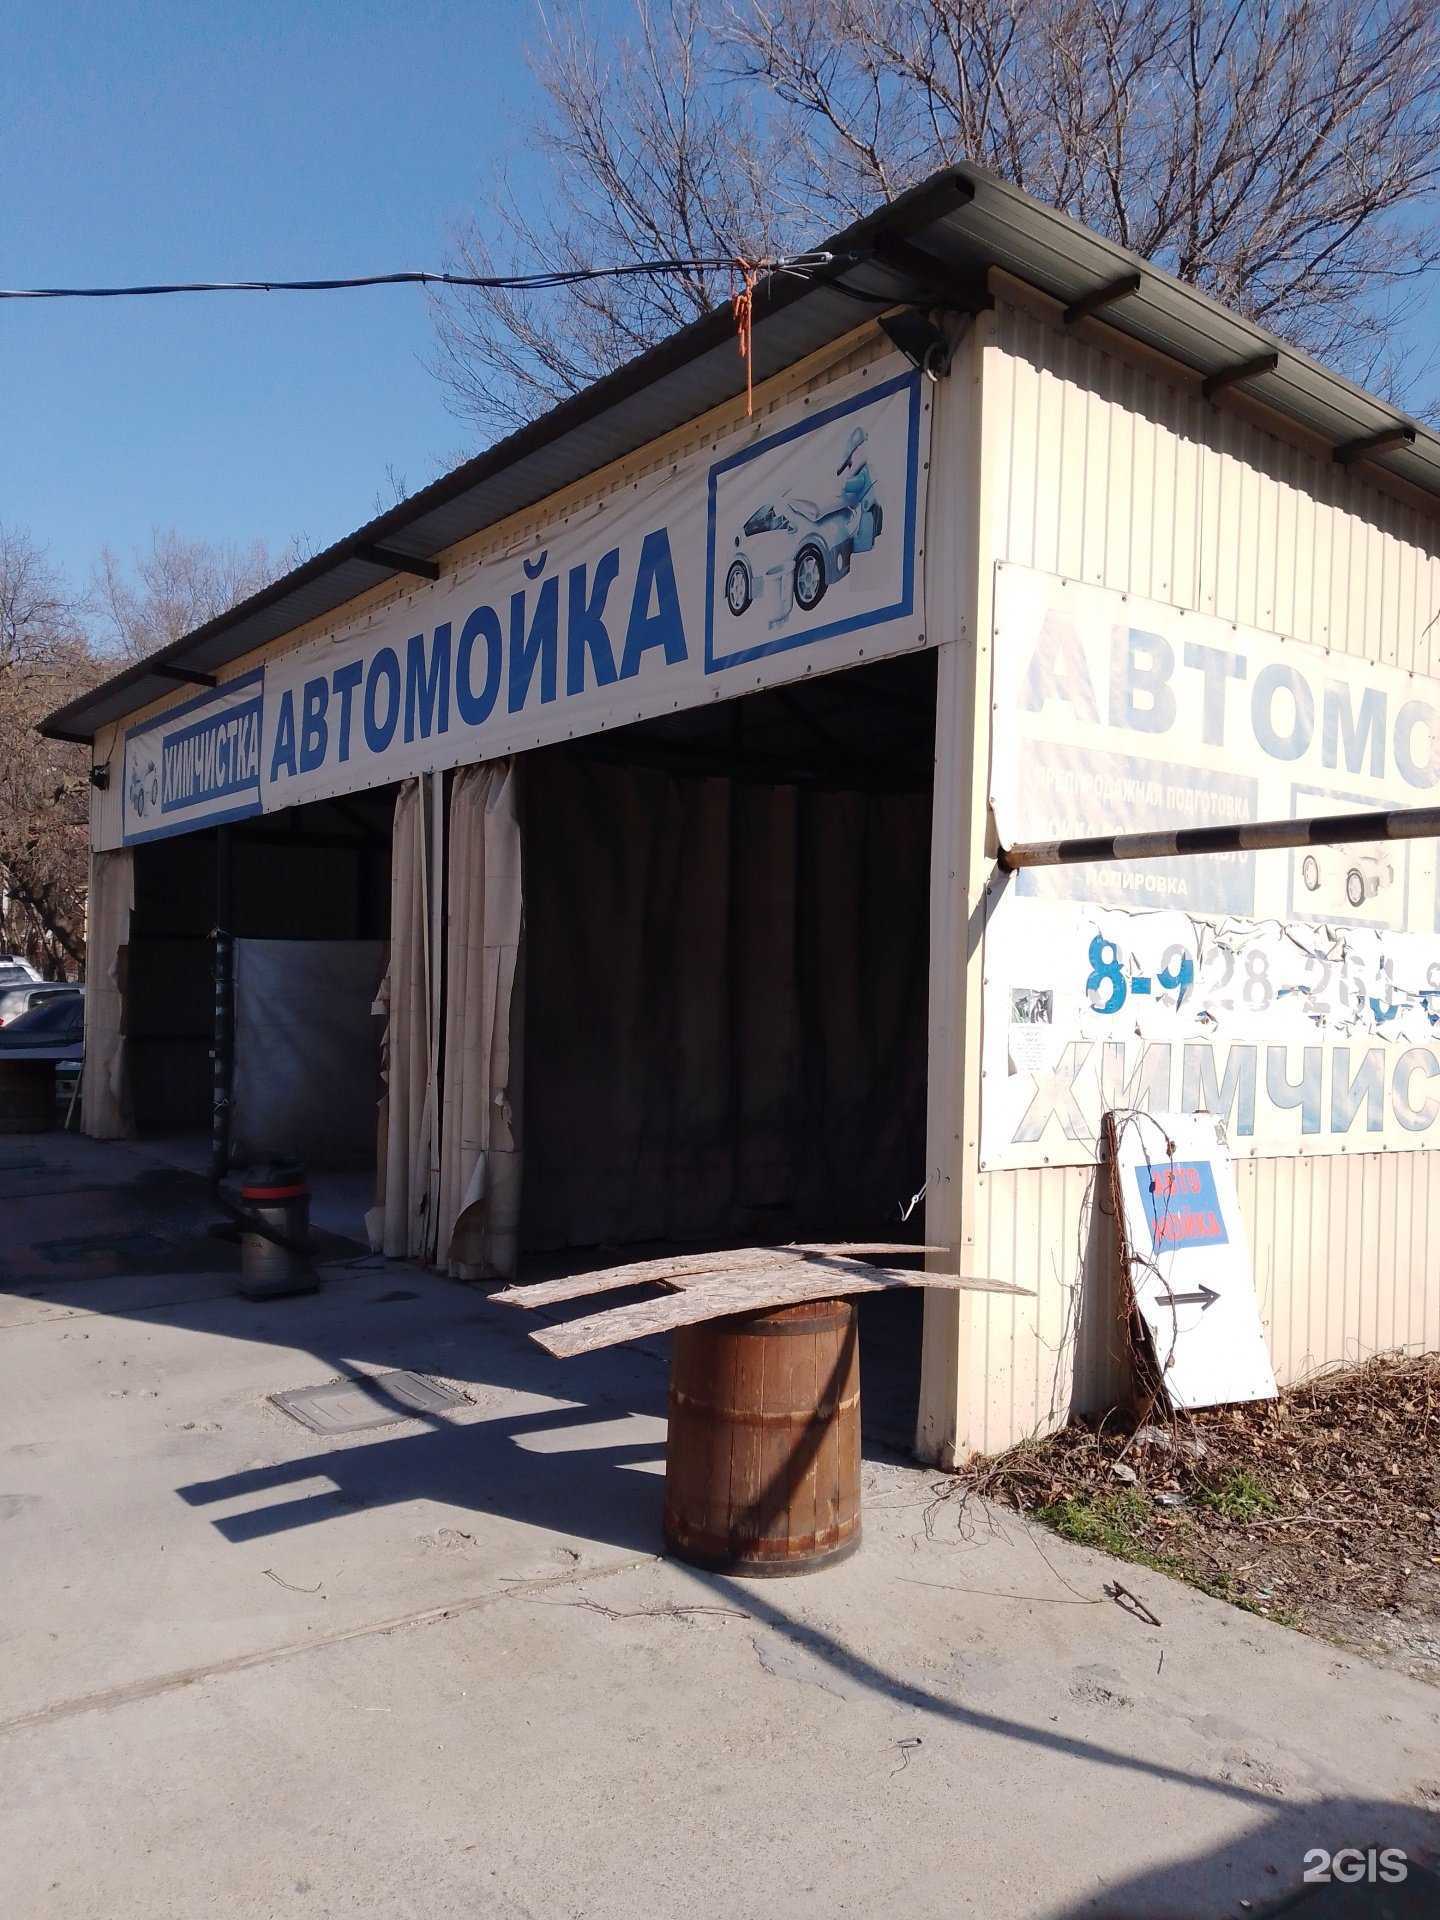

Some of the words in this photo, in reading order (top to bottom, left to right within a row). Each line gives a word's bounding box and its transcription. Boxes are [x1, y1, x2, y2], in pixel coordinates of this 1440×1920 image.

[270, 527, 688, 783] АВТОМОЙКА
[162, 711, 259, 803] ХИМЧИСТКА
[1166, 784, 1249, 820] ПОДГОТОВКА
[1086, 867, 1188, 896] ПОЛИРОВКА
